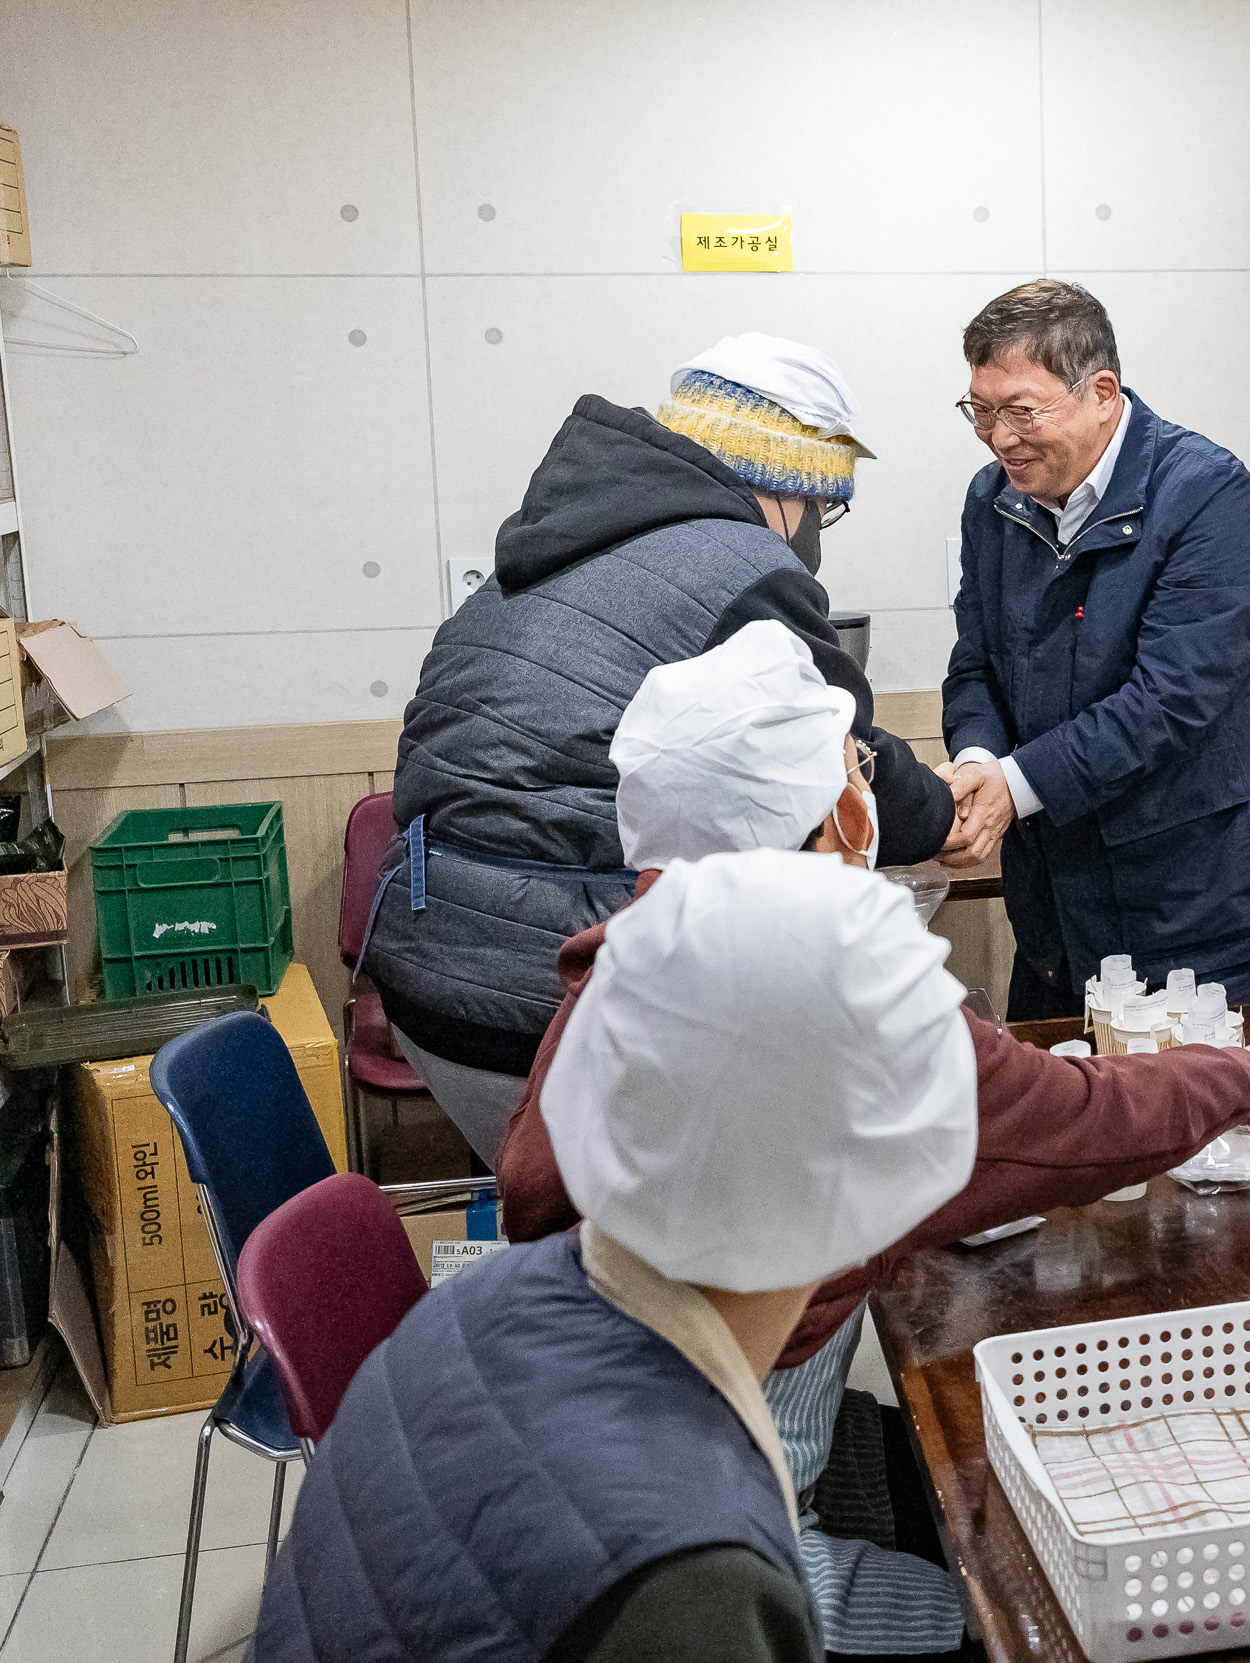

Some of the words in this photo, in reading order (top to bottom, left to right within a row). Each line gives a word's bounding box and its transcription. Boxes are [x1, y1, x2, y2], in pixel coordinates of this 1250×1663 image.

[696, 235, 778, 252] 제조가공실
[131, 1141, 160, 1181] 와인
[137, 1184, 163, 1247] 500ml
[141, 1297, 180, 1372] 제품명
